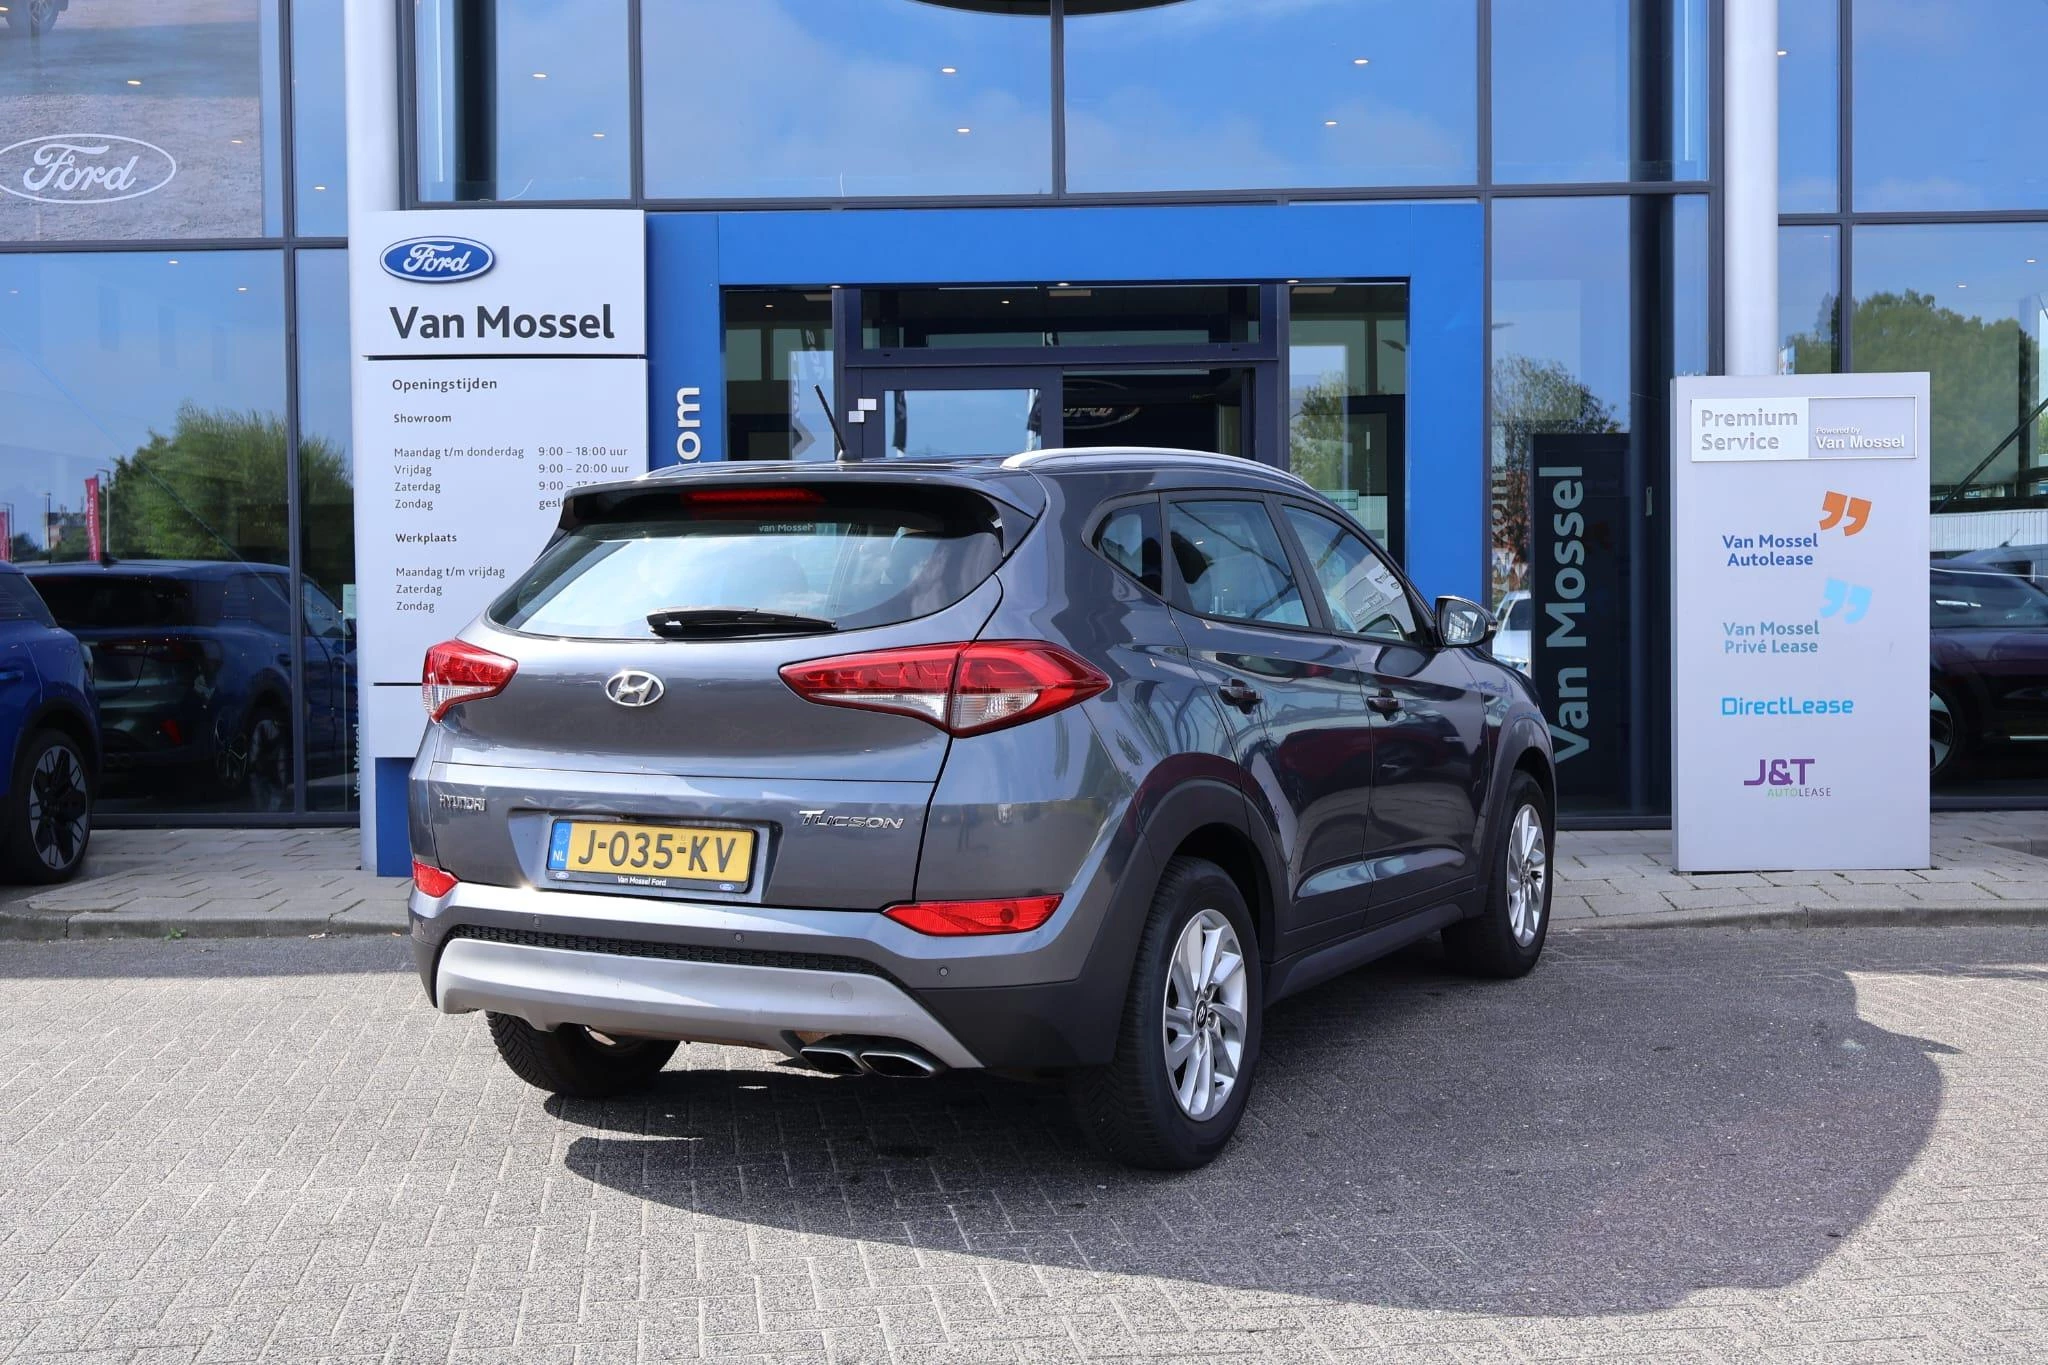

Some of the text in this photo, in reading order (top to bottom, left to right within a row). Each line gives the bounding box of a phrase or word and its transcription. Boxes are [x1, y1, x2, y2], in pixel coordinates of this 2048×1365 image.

[23, 143, 139, 191] Ford
[402, 243, 473, 274] Ford
[390, 303, 616, 340] Van Mossel
[392, 377, 498, 393] Openingstijden
[394, 413, 452, 424] Showroom
[1701, 408, 1799, 428] Premium
[1815, 426, 1862, 436] Powered by
[1701, 432, 1780, 451] Service
[1815, 434, 1905, 449] Van Mossel
[394, 446, 525, 460] Maandag t/m donderdag
[538, 446, 563, 456] 9:00
[575, 446, 607, 456] 18:00
[609, 447, 629, 456] uur
[394, 465, 433, 477] Vrijdag
[538, 463, 564, 474] 9:00
[575, 463, 608, 474] 20:00
[611, 464, 631, 473] uur
[394, 482, 442, 494] Zaterdag
[538, 480, 564, 491] 9:00
[395, 499, 434, 511] Zondag
[538, 497, 565, 511] gesl
[395, 533, 458, 545] Werkplaats
[1722, 533, 1819, 549] Van Mossel
[1727, 552, 1814, 567] Autolease
[396, 566, 506, 579] Maandag t/m vrijdag
[396, 584, 443, 596] Zaterdag
[396, 601, 435, 614] Zondag
[1538, 465, 1591, 765] Van Mossel
[1723, 620, 1820, 636] Van Mossel
[1724, 640, 1818, 654] Privé Lease
[1721, 697, 1854, 716] DirectLease
[1744, 758, 1816, 786] J&T
[1767, 787, 1831, 798] AUTOLEASE
[439, 794, 487, 811] HYUNDAI
[552, 850, 565, 862] NL
[578, 829, 737, 873] J-035-KV
[617, 875, 667, 887] Van Mossel Ford
